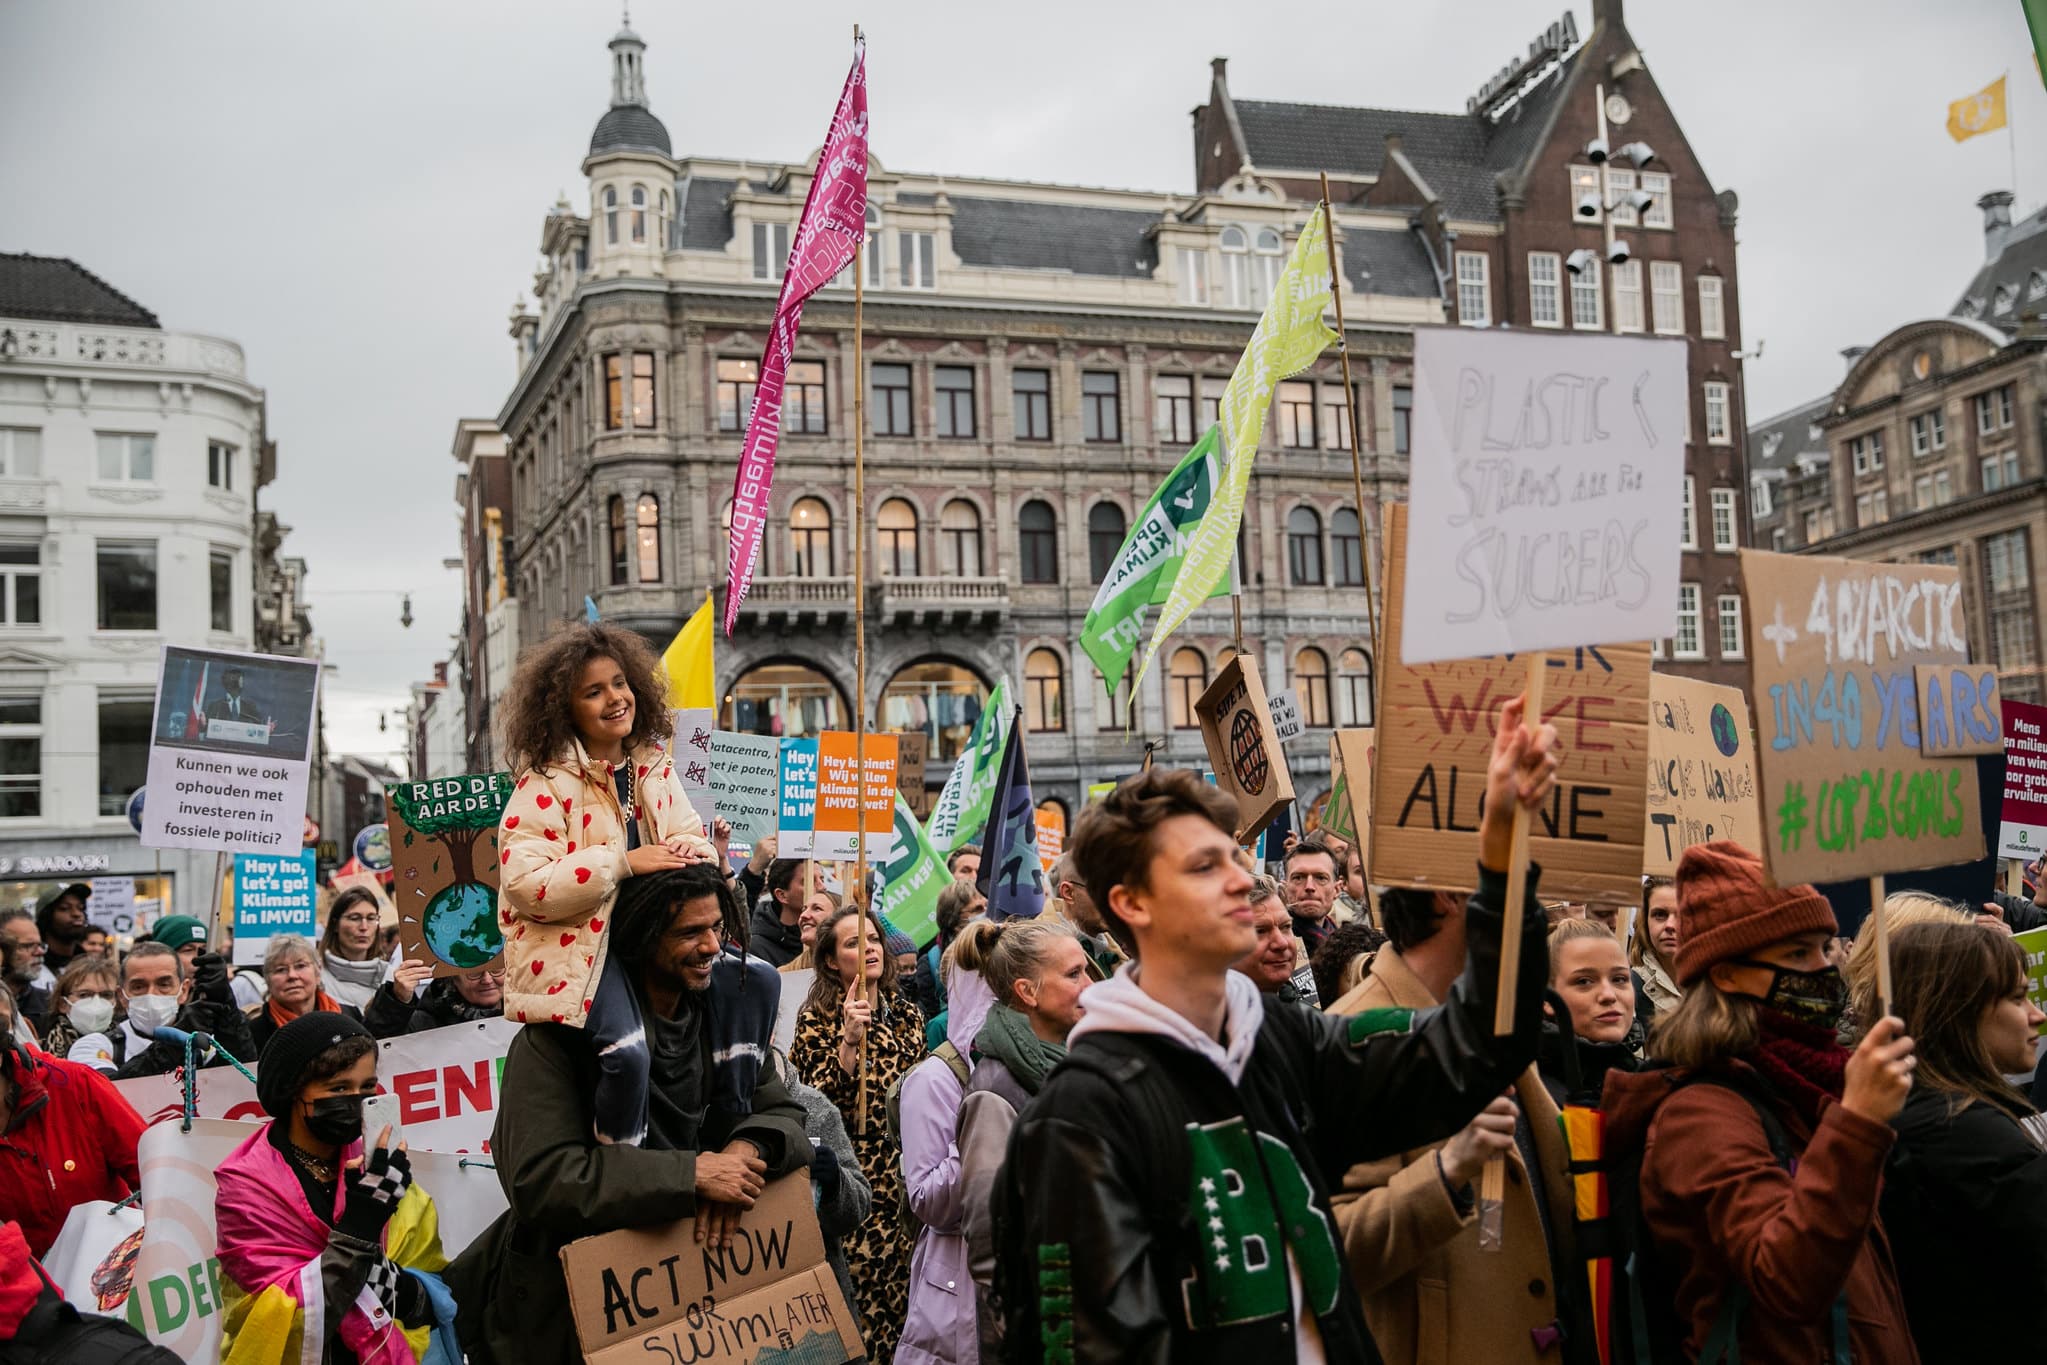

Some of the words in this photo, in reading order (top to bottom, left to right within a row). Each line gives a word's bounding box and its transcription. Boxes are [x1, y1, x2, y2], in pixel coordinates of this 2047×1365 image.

[1453, 367, 1611, 453] PLASTIC
[1448, 457, 1561, 528] STRAWS
[1445, 518, 1651, 624] SUCKERS
[1872, 669, 2000, 752] YEARS
[2013, 718, 2041, 736] Mens
[787, 750, 815, 767] Hey
[823, 756, 849, 770] Hey
[176, 757, 232, 775] Kunnen
[236, 764, 258, 778] we
[262, 767, 289, 781] ook
[727, 763, 739, 774] je
[829, 769, 849, 784] Wij
[851, 772, 888, 783] wllen
[175, 780, 250, 798] ophouden
[254, 789, 284, 802] met
[412, 780, 462, 802] RED
[470, 775, 498, 795] DE
[728, 783, 768, 796] groene
[820, 783, 863, 796] klimaa
[867, 786, 878, 797] in
[880, 786, 894, 797] de
[740, 806, 769, 816] gaan
[783, 802, 796, 817] in
[1396, 762, 1613, 841] ALNE
[179, 801, 256, 821] investeren
[260, 808, 273, 823] in
[164, 822, 221, 839] fossiele
[224, 828, 282, 845] politici?
[20, 854, 110, 873] SWAROVSKI
[244, 859, 277, 877] Hey
[280, 859, 306, 876] ho,
[282, 876, 309, 893] go!
[242, 893, 310, 907] Klimaat
[240, 910, 257, 924] in
[261, 909, 311, 924] IMVO!
[601, 1255, 681, 1334] ACT
[702, 1220, 793, 1293] NOW
[686, 1295, 725, 1330] OR
[769, 1291, 834, 1334] LATER
